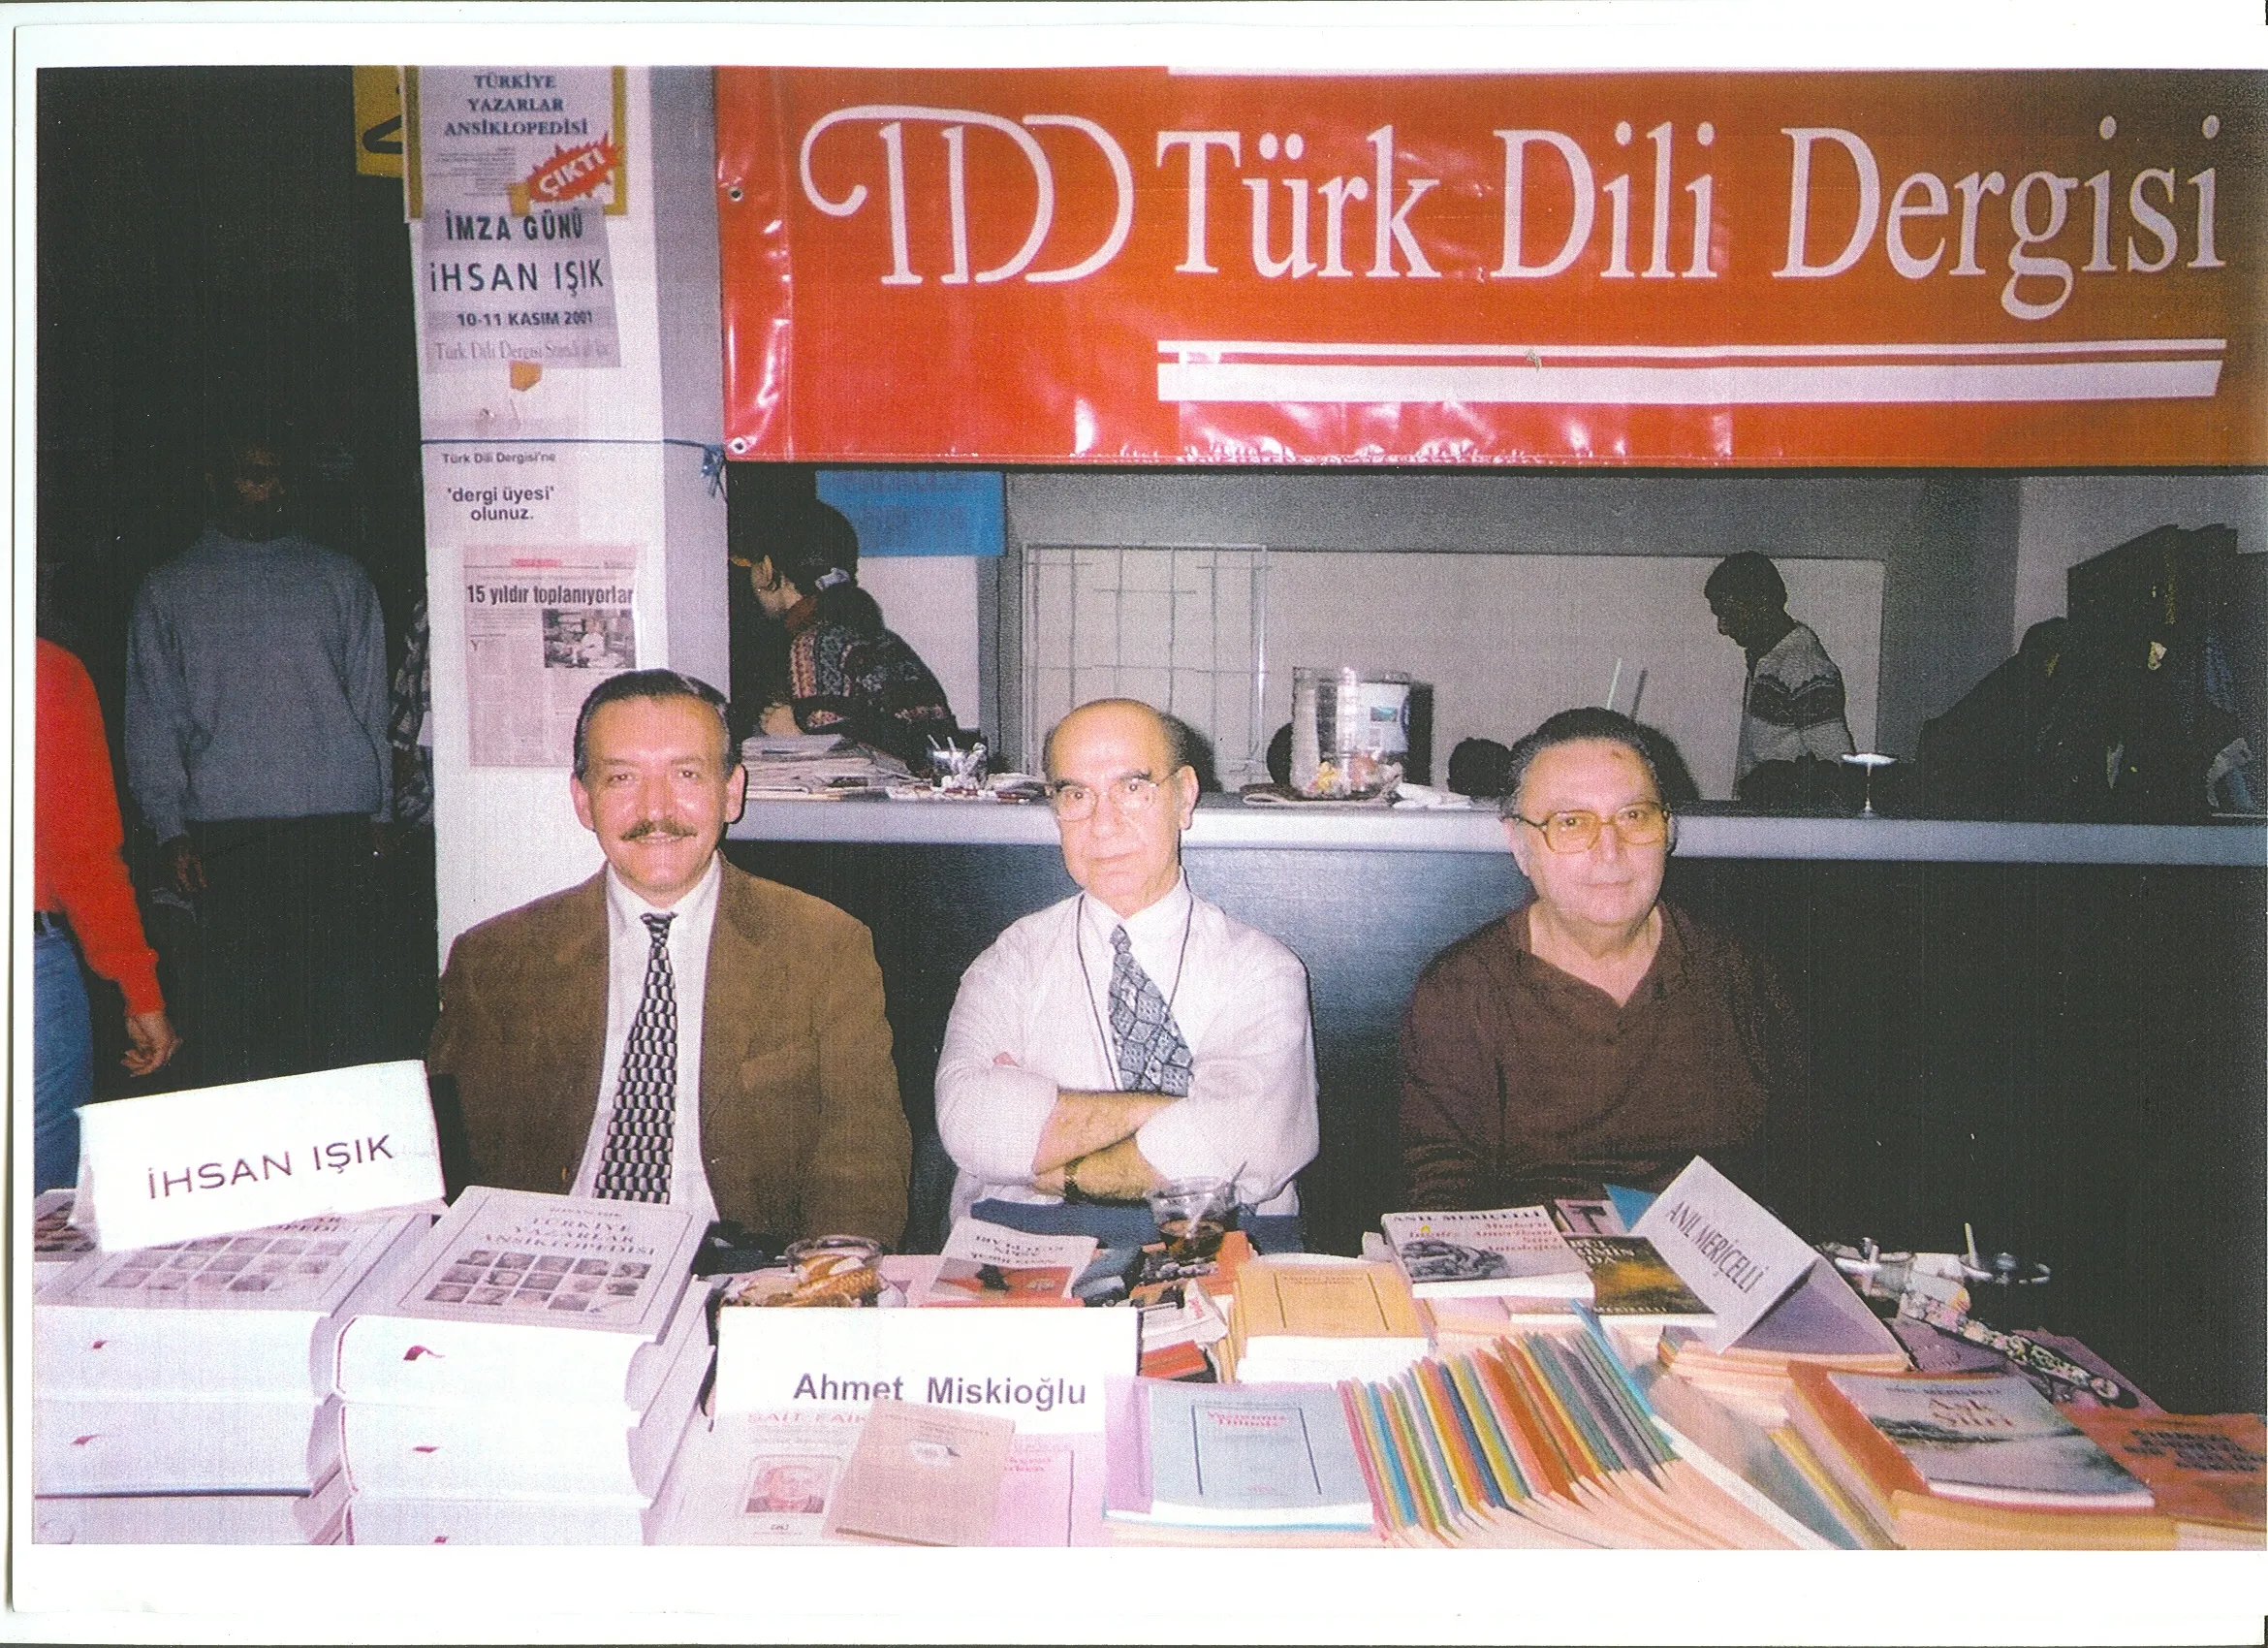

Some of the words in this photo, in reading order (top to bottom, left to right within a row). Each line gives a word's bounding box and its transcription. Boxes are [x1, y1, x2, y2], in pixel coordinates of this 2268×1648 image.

[474, 73, 556, 89] TÜRKİYE
[467, 98, 564, 111] YAZARLAR
[444, 117, 588, 137] ANSİKLOPEDİSİ
[539, 146, 606, 197] ÇIKTI
[446, 209, 512, 240] İMZA
[523, 208, 583, 240] GÜNÜ
[1156, 124, 1441, 280] Türk
[1490, 120, 1718, 279] Dili
[1772, 114, 2227, 321] Dergisi
[429, 262, 538, 292] İHSAN
[554, 258, 604, 297] IŞIK
[457, 312, 502, 327] 10-11
[508, 311, 559, 327] KASIM
[564, 309, 593, 325] 2001
[442, 453, 470, 464] Türk
[475, 452, 493, 463] Dili
[471, 506, 534, 522] olunuz.
[467, 585, 486, 603] 15
[489, 585, 529, 605] yıldır
[533, 585, 634, 605] toplanıyorlar
[148, 1151, 292, 1199] İHSAN
[313, 1133, 394, 1174] IŞIK
[1668, 1202, 1702, 1238] ANIL
[1692, 1223, 1770, 1293] MERİÇELLİ
[793, 1373, 904, 1401] Ahmet
[928, 1377, 1086, 1411] Miskioğlu
